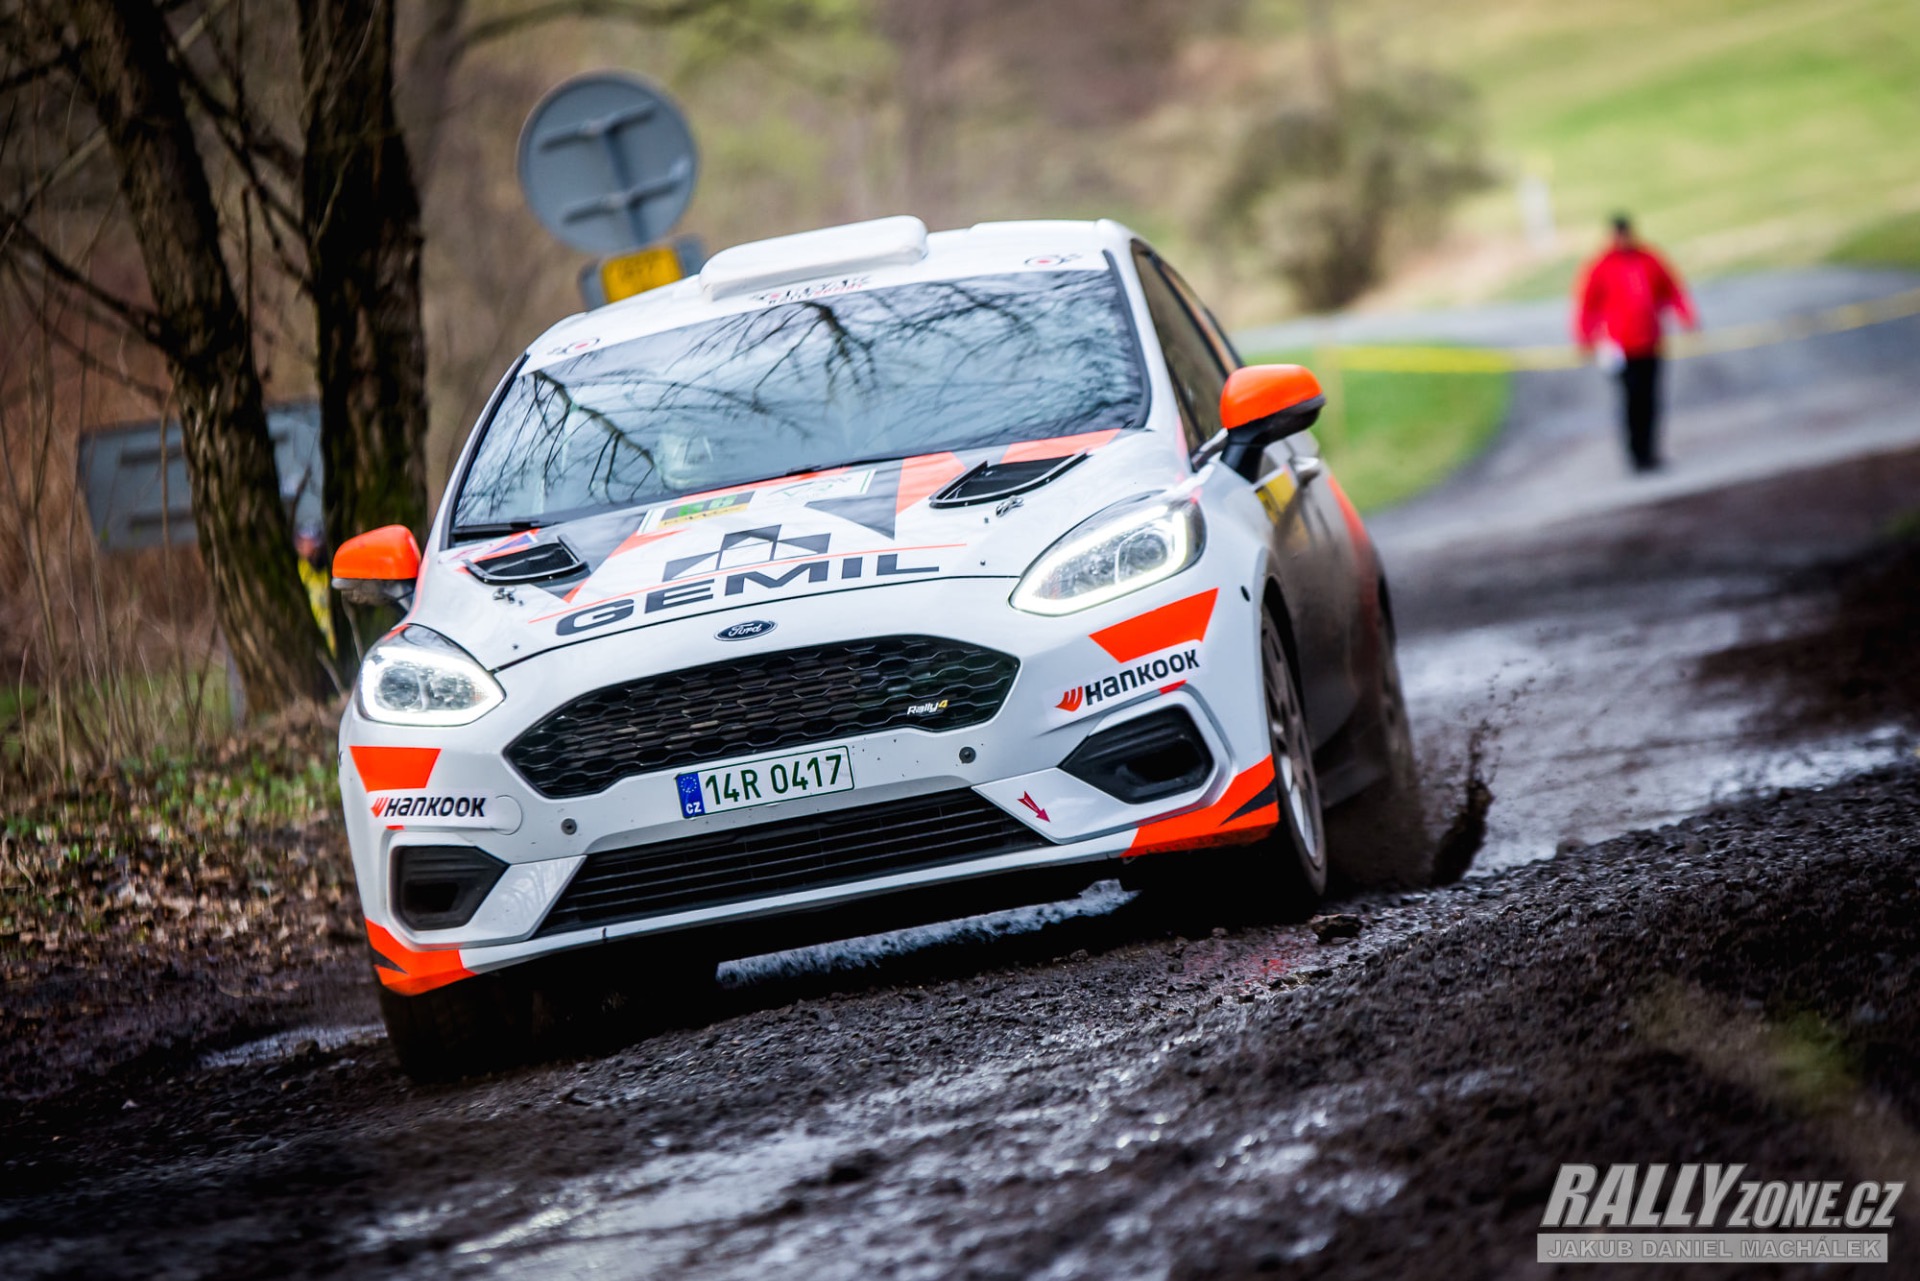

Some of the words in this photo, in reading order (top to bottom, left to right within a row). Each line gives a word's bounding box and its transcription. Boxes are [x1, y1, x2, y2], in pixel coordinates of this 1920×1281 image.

[556, 553, 940, 636] GEMIL
[728, 623, 763, 637] Ford
[906, 700, 949, 715] Rally4
[705, 769, 762, 805] 14R
[770, 754, 842, 794] 0417
[685, 801, 702, 814] CZ
